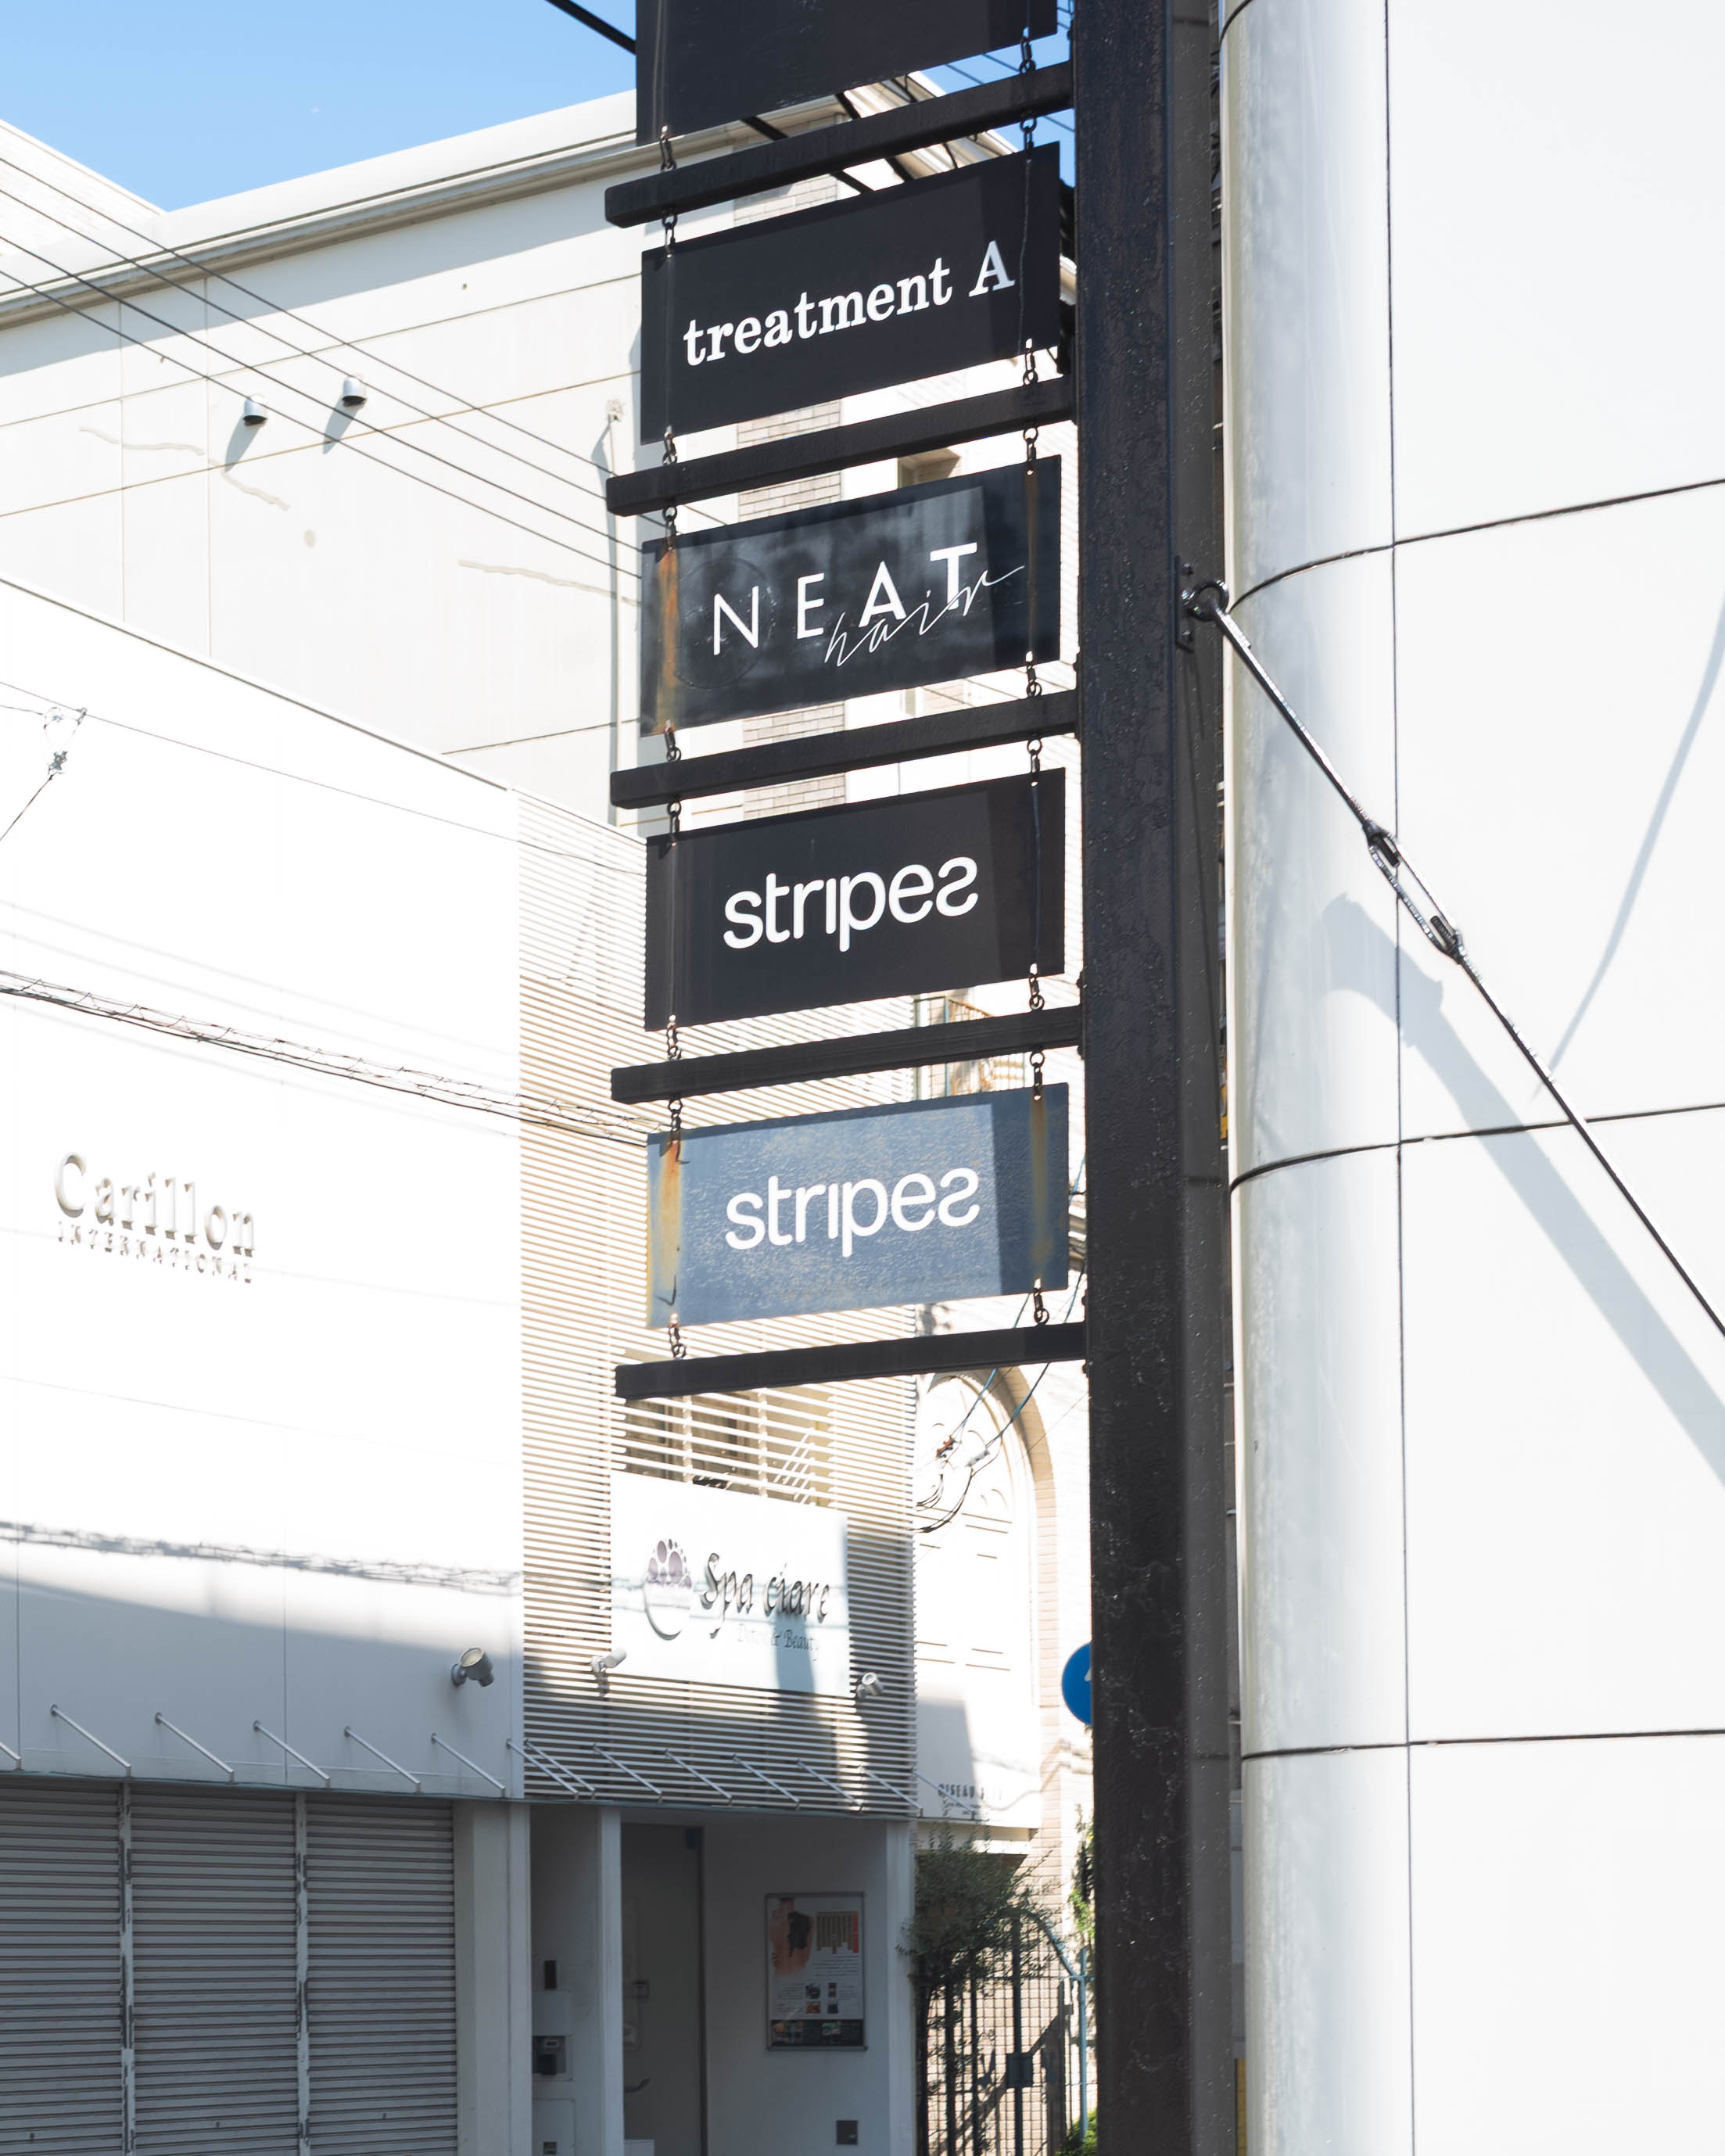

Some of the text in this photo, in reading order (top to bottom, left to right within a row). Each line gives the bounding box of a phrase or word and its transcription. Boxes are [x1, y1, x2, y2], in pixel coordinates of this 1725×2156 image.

[683, 239, 1016, 367] treatment A
[712, 542, 977, 655] NEAT
[824, 565, 1025, 668] hair
[723, 856, 980, 952] stripes
[54, 1152, 254, 1257] Carillon
[724, 1167, 981, 1257] stripes
[700, 1552, 754, 1639] Spa
